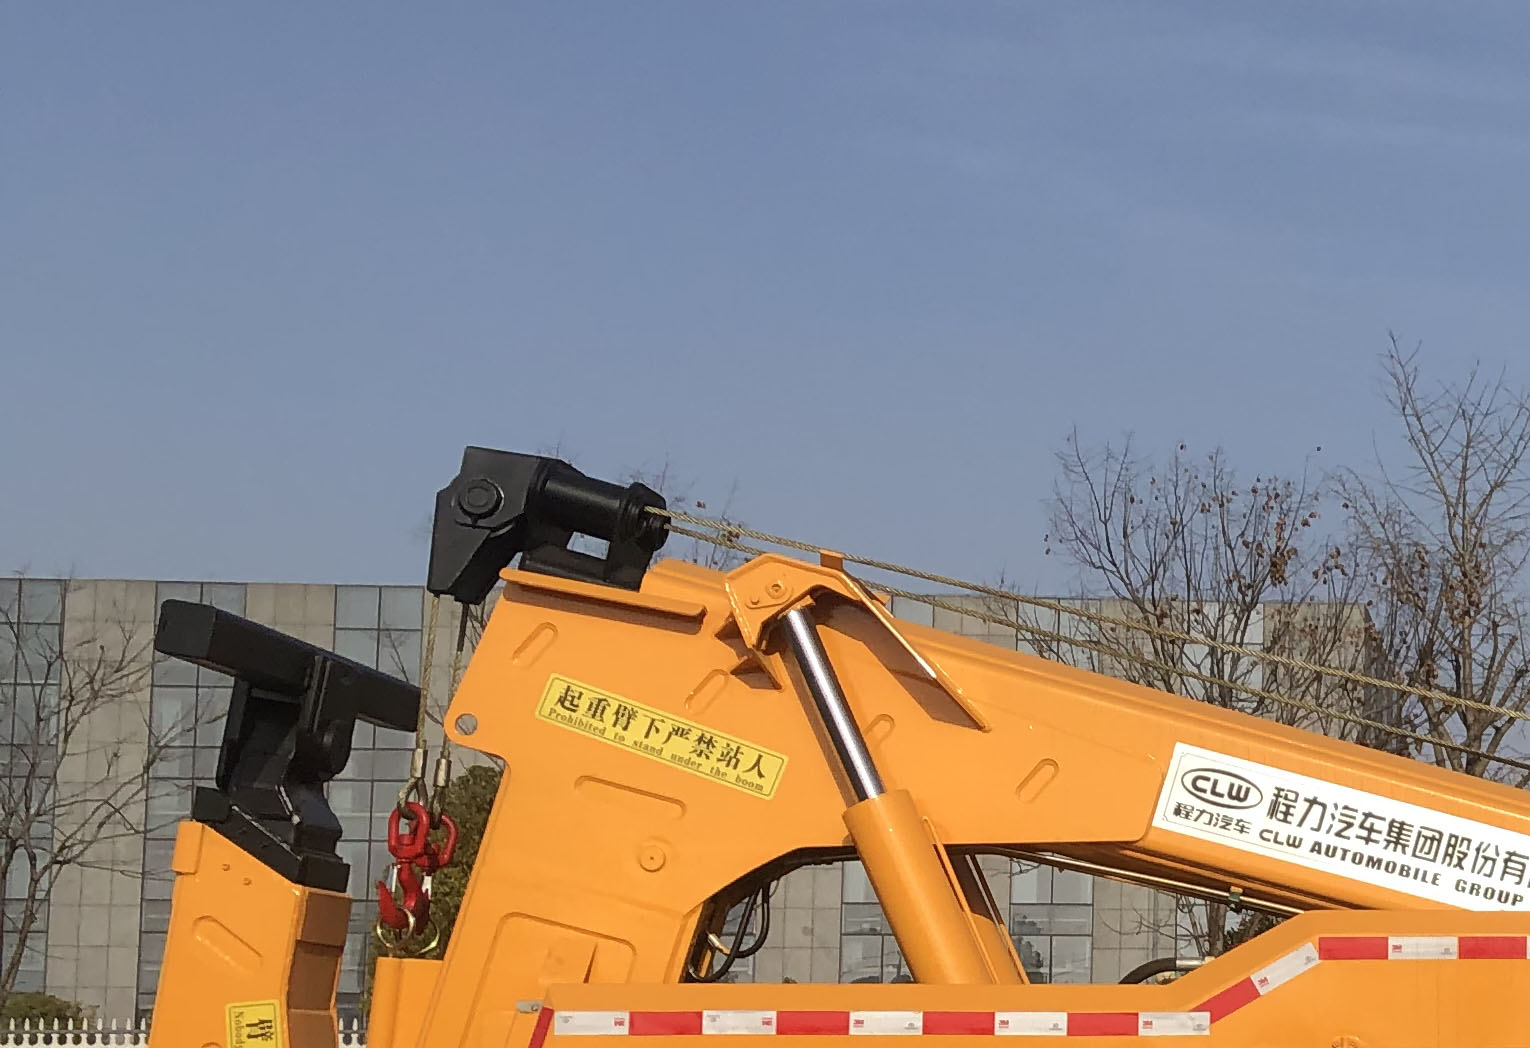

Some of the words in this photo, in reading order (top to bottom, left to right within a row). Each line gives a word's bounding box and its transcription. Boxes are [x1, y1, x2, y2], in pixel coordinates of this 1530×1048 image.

[548, 707, 606, 737] Prohibited
[613, 732, 626, 743] to
[632, 738, 664, 756] stand
[670, 753, 703, 770] under
[709, 766, 728, 779] the
[735, 774, 764, 791] boom
[554, 685, 766, 779] 起重臂下严禁站人
[1172, 801, 1252, 835] 程力汽车
[1191, 775, 1251, 803] CLW
[1259, 828, 1303, 849] CLW
[1309, 840, 1442, 887] AUTOMOBILE
[1454, 878, 1524, 907] GROUP
